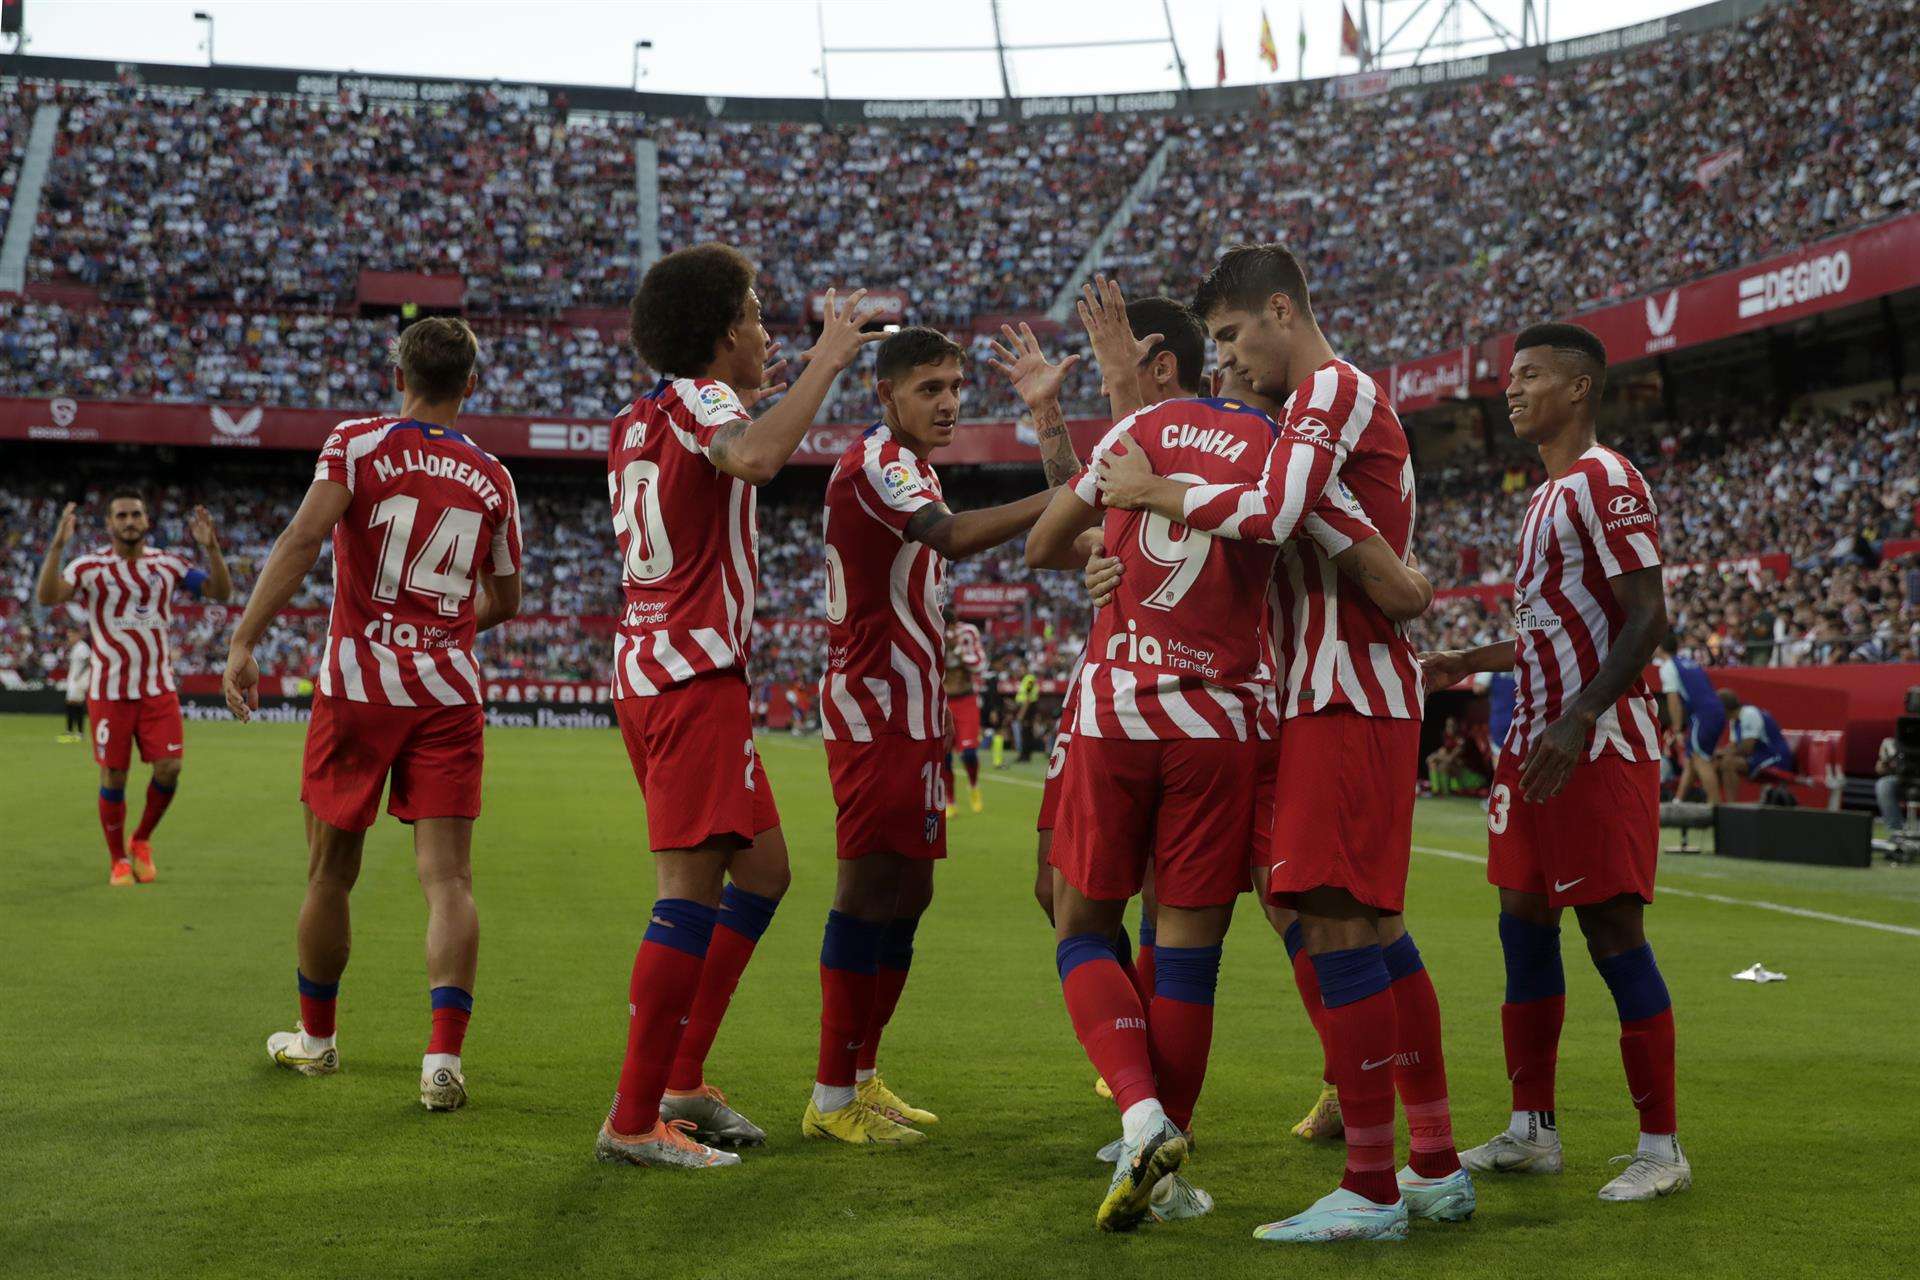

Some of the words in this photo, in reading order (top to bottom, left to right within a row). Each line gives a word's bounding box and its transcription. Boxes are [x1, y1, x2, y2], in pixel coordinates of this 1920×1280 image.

[1764, 250, 1850, 311] DEGIRO
[1161, 423, 1249, 464] CUNHA
[405, 449, 504, 512] LLORENTE
[1138, 472, 1214, 612] 9
[1606, 513, 1652, 531] HYUNDAI
[368, 493, 486, 618] 14
[632, 601, 668, 613] Money
[364, 611, 420, 648] ria
[1105, 618, 1163, 667] ria
[1166, 653, 1220, 679] Transfer
[1167, 638, 1215, 663] Money
[96, 718, 110, 745] 6
[537, 708, 611, 728] Benito
[1046, 732, 1072, 780] 5
[921, 760, 946, 811] 16
